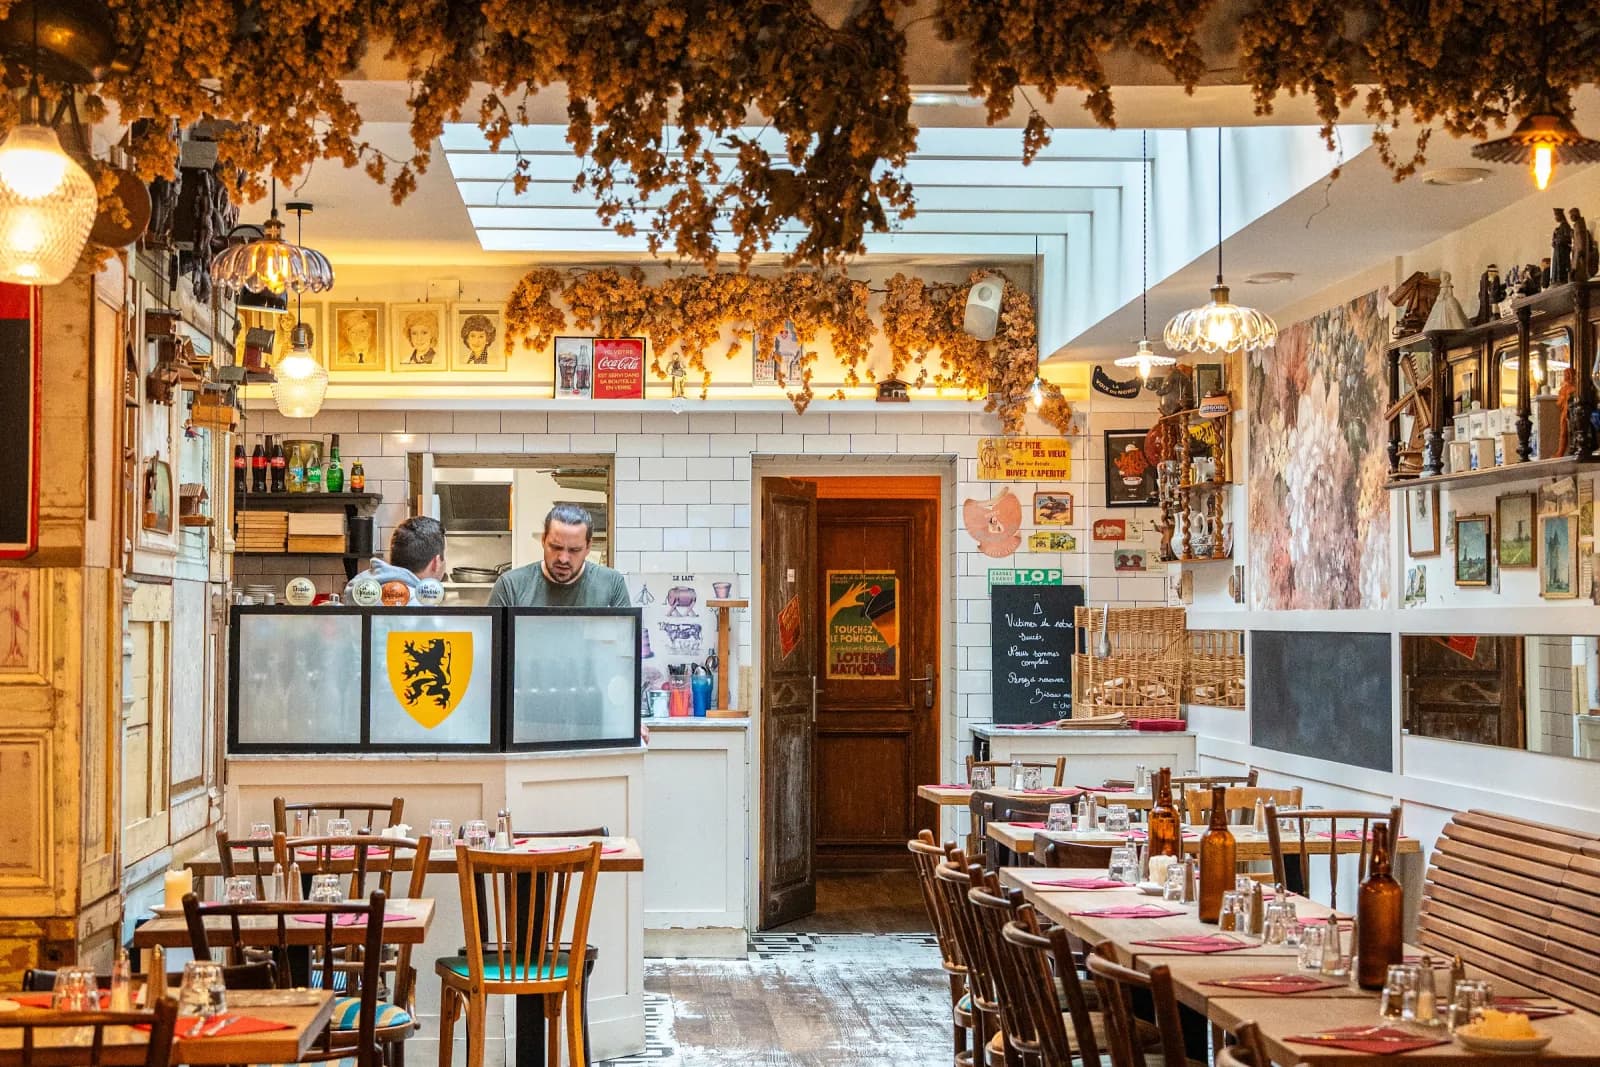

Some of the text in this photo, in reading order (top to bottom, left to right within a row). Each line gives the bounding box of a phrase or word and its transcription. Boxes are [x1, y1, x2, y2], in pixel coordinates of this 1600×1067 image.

[598, 356, 640, 370] Coca-Cola
[1096, 379, 1109, 391] VOIX
[1033, 449, 1066, 458] DES VIEUX
[1006, 469, 1027, 477] BUVEZ
[1016, 570, 1061, 582] TOP
[1040, 617, 1051, 627] de
[834, 625, 873, 634] TOUCHEZ
[830, 634, 838, 643] LE
